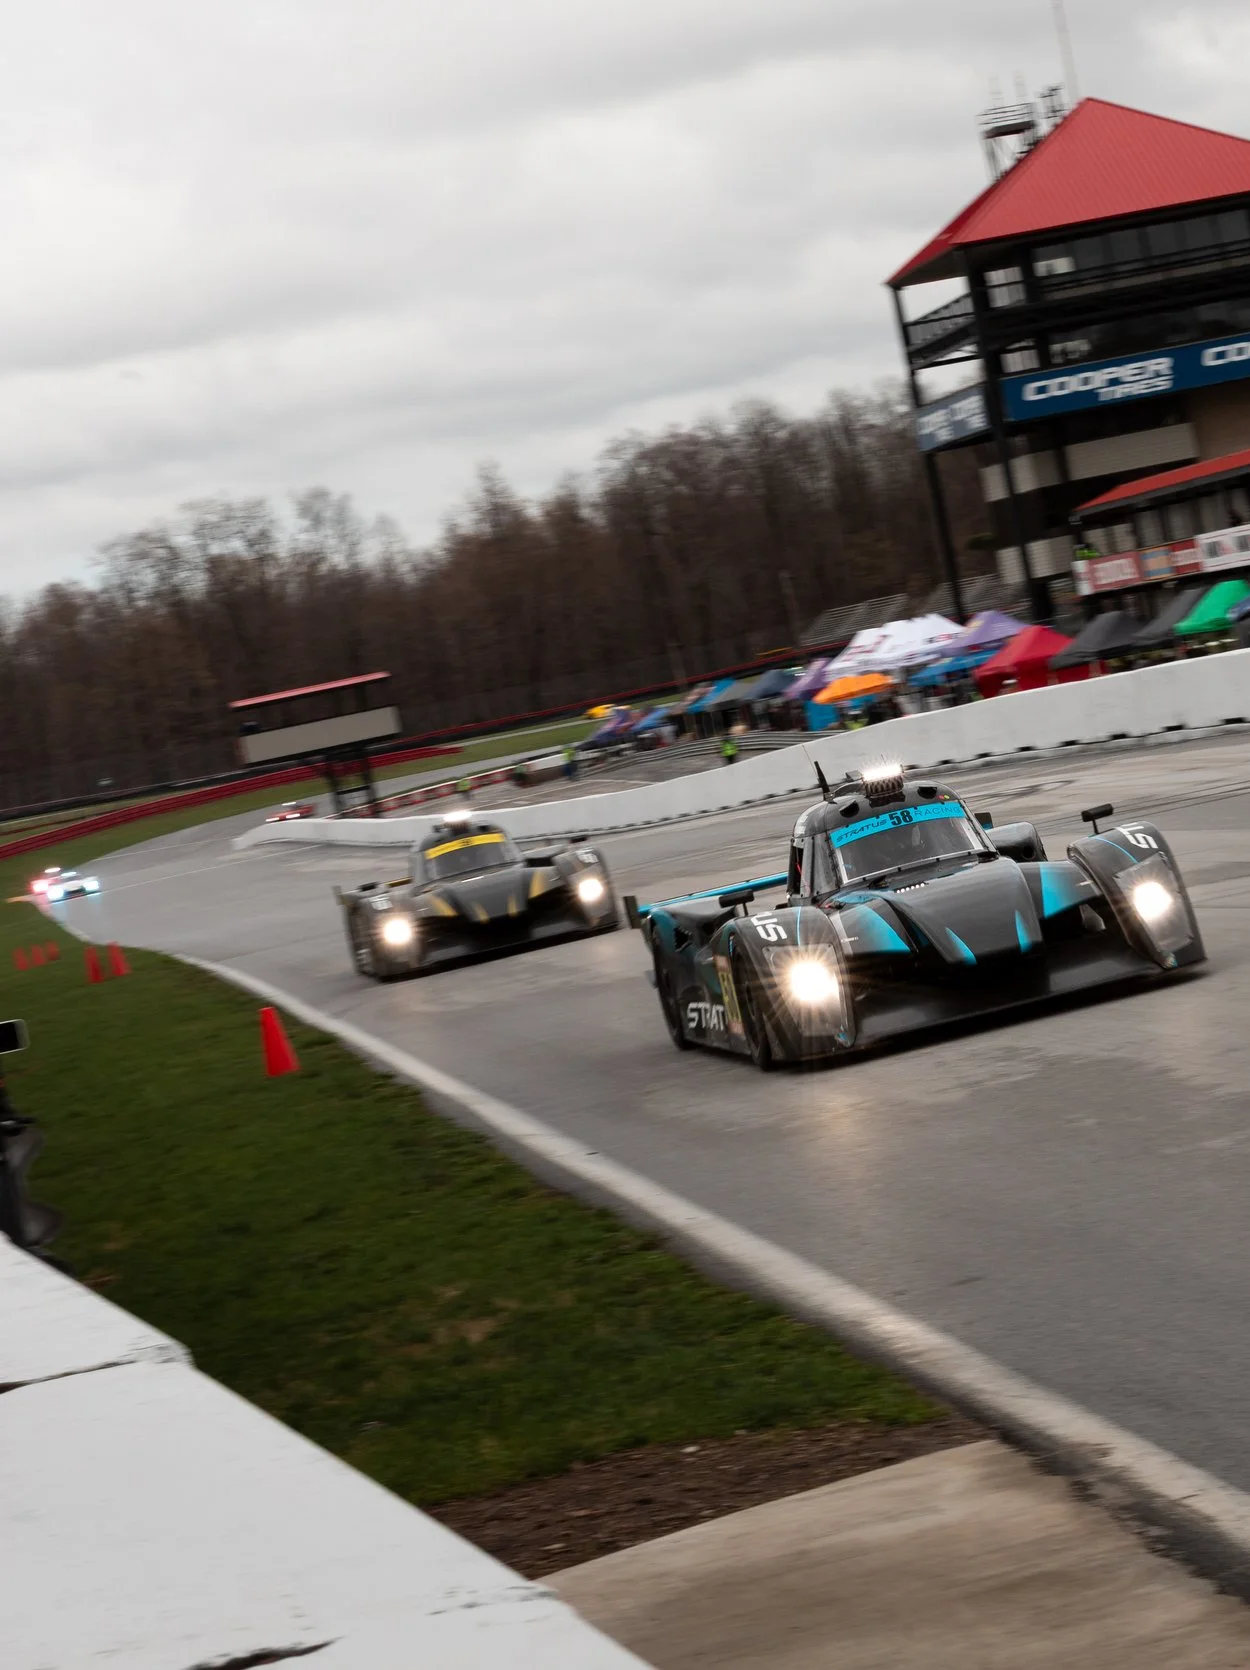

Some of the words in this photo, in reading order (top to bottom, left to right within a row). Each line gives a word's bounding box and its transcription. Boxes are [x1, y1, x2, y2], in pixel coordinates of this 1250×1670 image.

[1022, 357, 1175, 401] COOPER
[1094, 374, 1175, 401] TIRES
[836, 819, 888, 842] STRATUS
[889, 809, 914, 826] 58
[914, 805, 961, 818] RACING
[686, 1001, 728, 1032] STRAT
